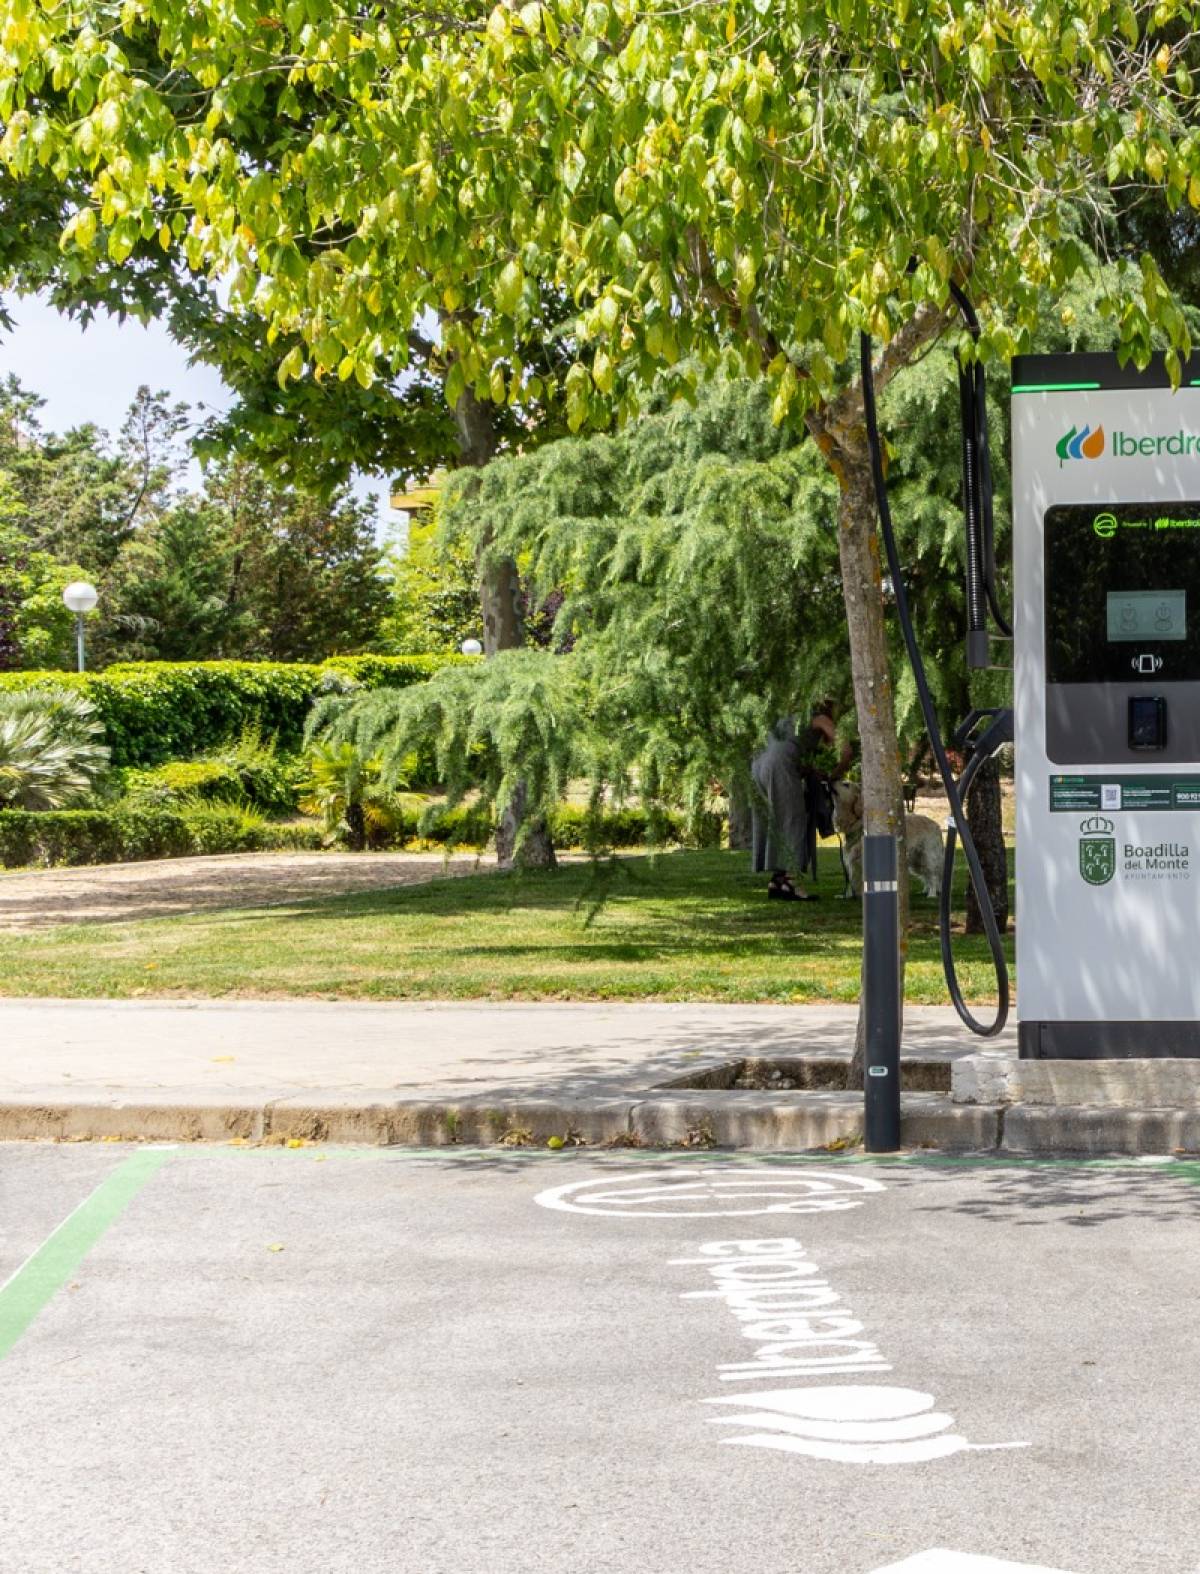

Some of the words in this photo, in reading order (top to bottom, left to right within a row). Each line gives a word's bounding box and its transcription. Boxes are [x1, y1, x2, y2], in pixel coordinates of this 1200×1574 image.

[1124, 844, 1189, 858] Boadilla
[1124, 860, 1142, 870] del
[1145, 858, 1189, 870] Monte
[667, 1238, 893, 1381] Iberdrola
